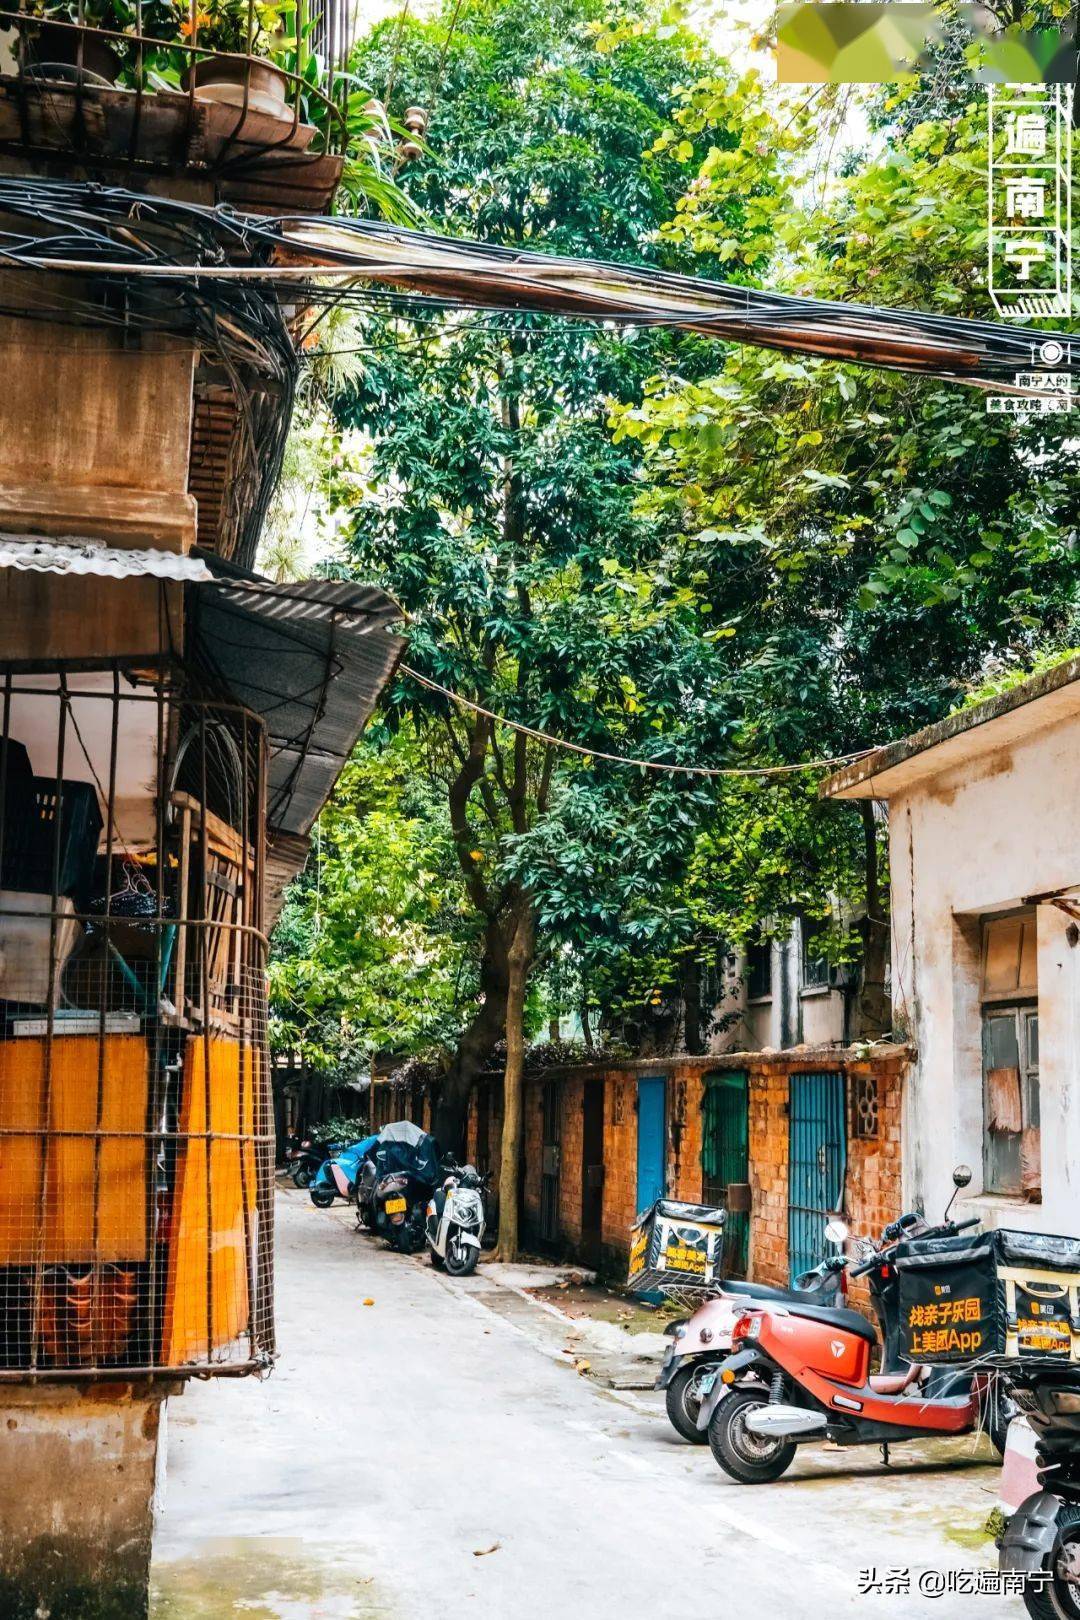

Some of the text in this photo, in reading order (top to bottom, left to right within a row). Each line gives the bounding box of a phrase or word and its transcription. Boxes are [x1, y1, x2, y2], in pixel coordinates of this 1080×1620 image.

[909, 1298, 981, 1328] 找亲子乐园
[910, 1328, 982, 1353] 上美团App
